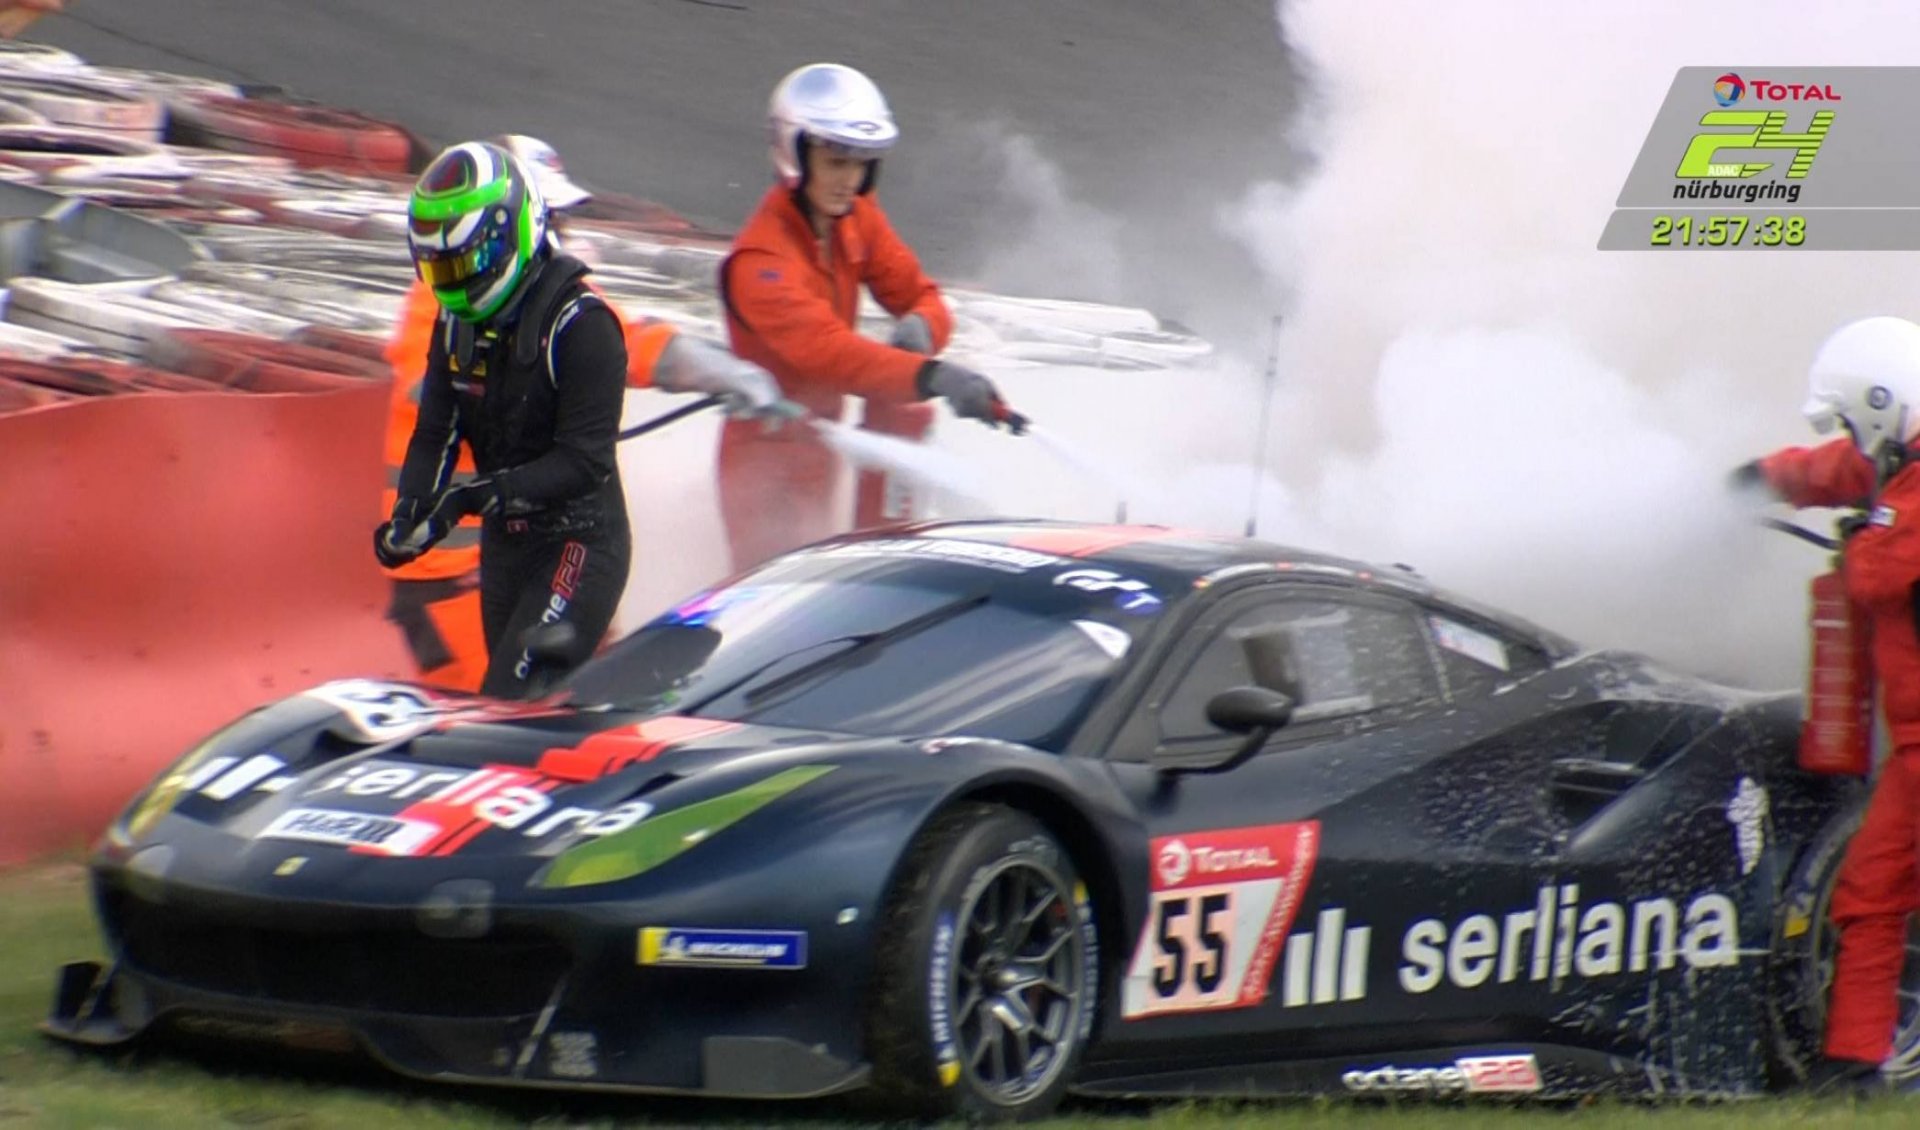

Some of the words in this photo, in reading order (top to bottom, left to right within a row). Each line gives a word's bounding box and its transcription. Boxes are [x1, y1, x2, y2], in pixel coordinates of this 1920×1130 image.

[1190, 845, 1280, 873] TOTAL
[1153, 893, 1231, 998] 55
[1398, 883, 1739, 994] serliana
